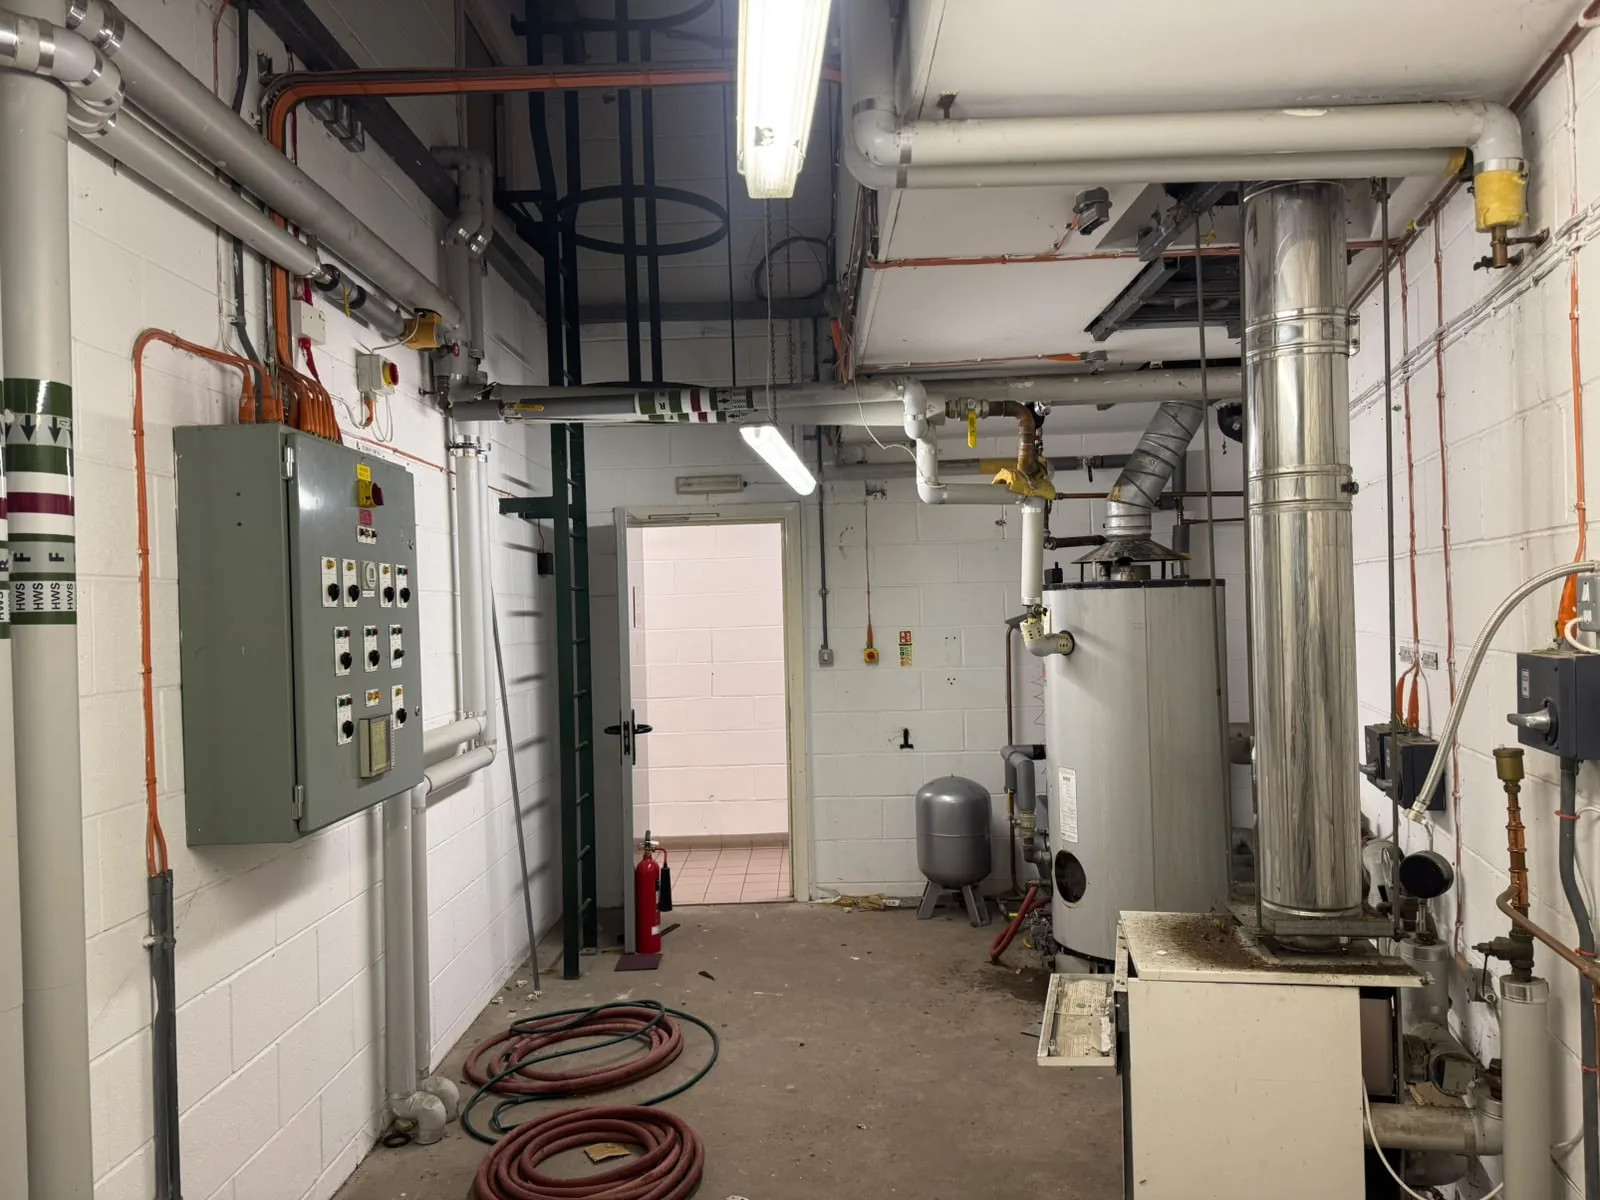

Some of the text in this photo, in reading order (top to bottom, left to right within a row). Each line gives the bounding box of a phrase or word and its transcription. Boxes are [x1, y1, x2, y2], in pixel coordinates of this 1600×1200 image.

[13, 552, 31, 562] F
[48, 552, 65, 562] F
[15, 583, 25, 611] HWS
[32, 583, 44, 610] HWS
[51, 583, 60, 610] HWS
